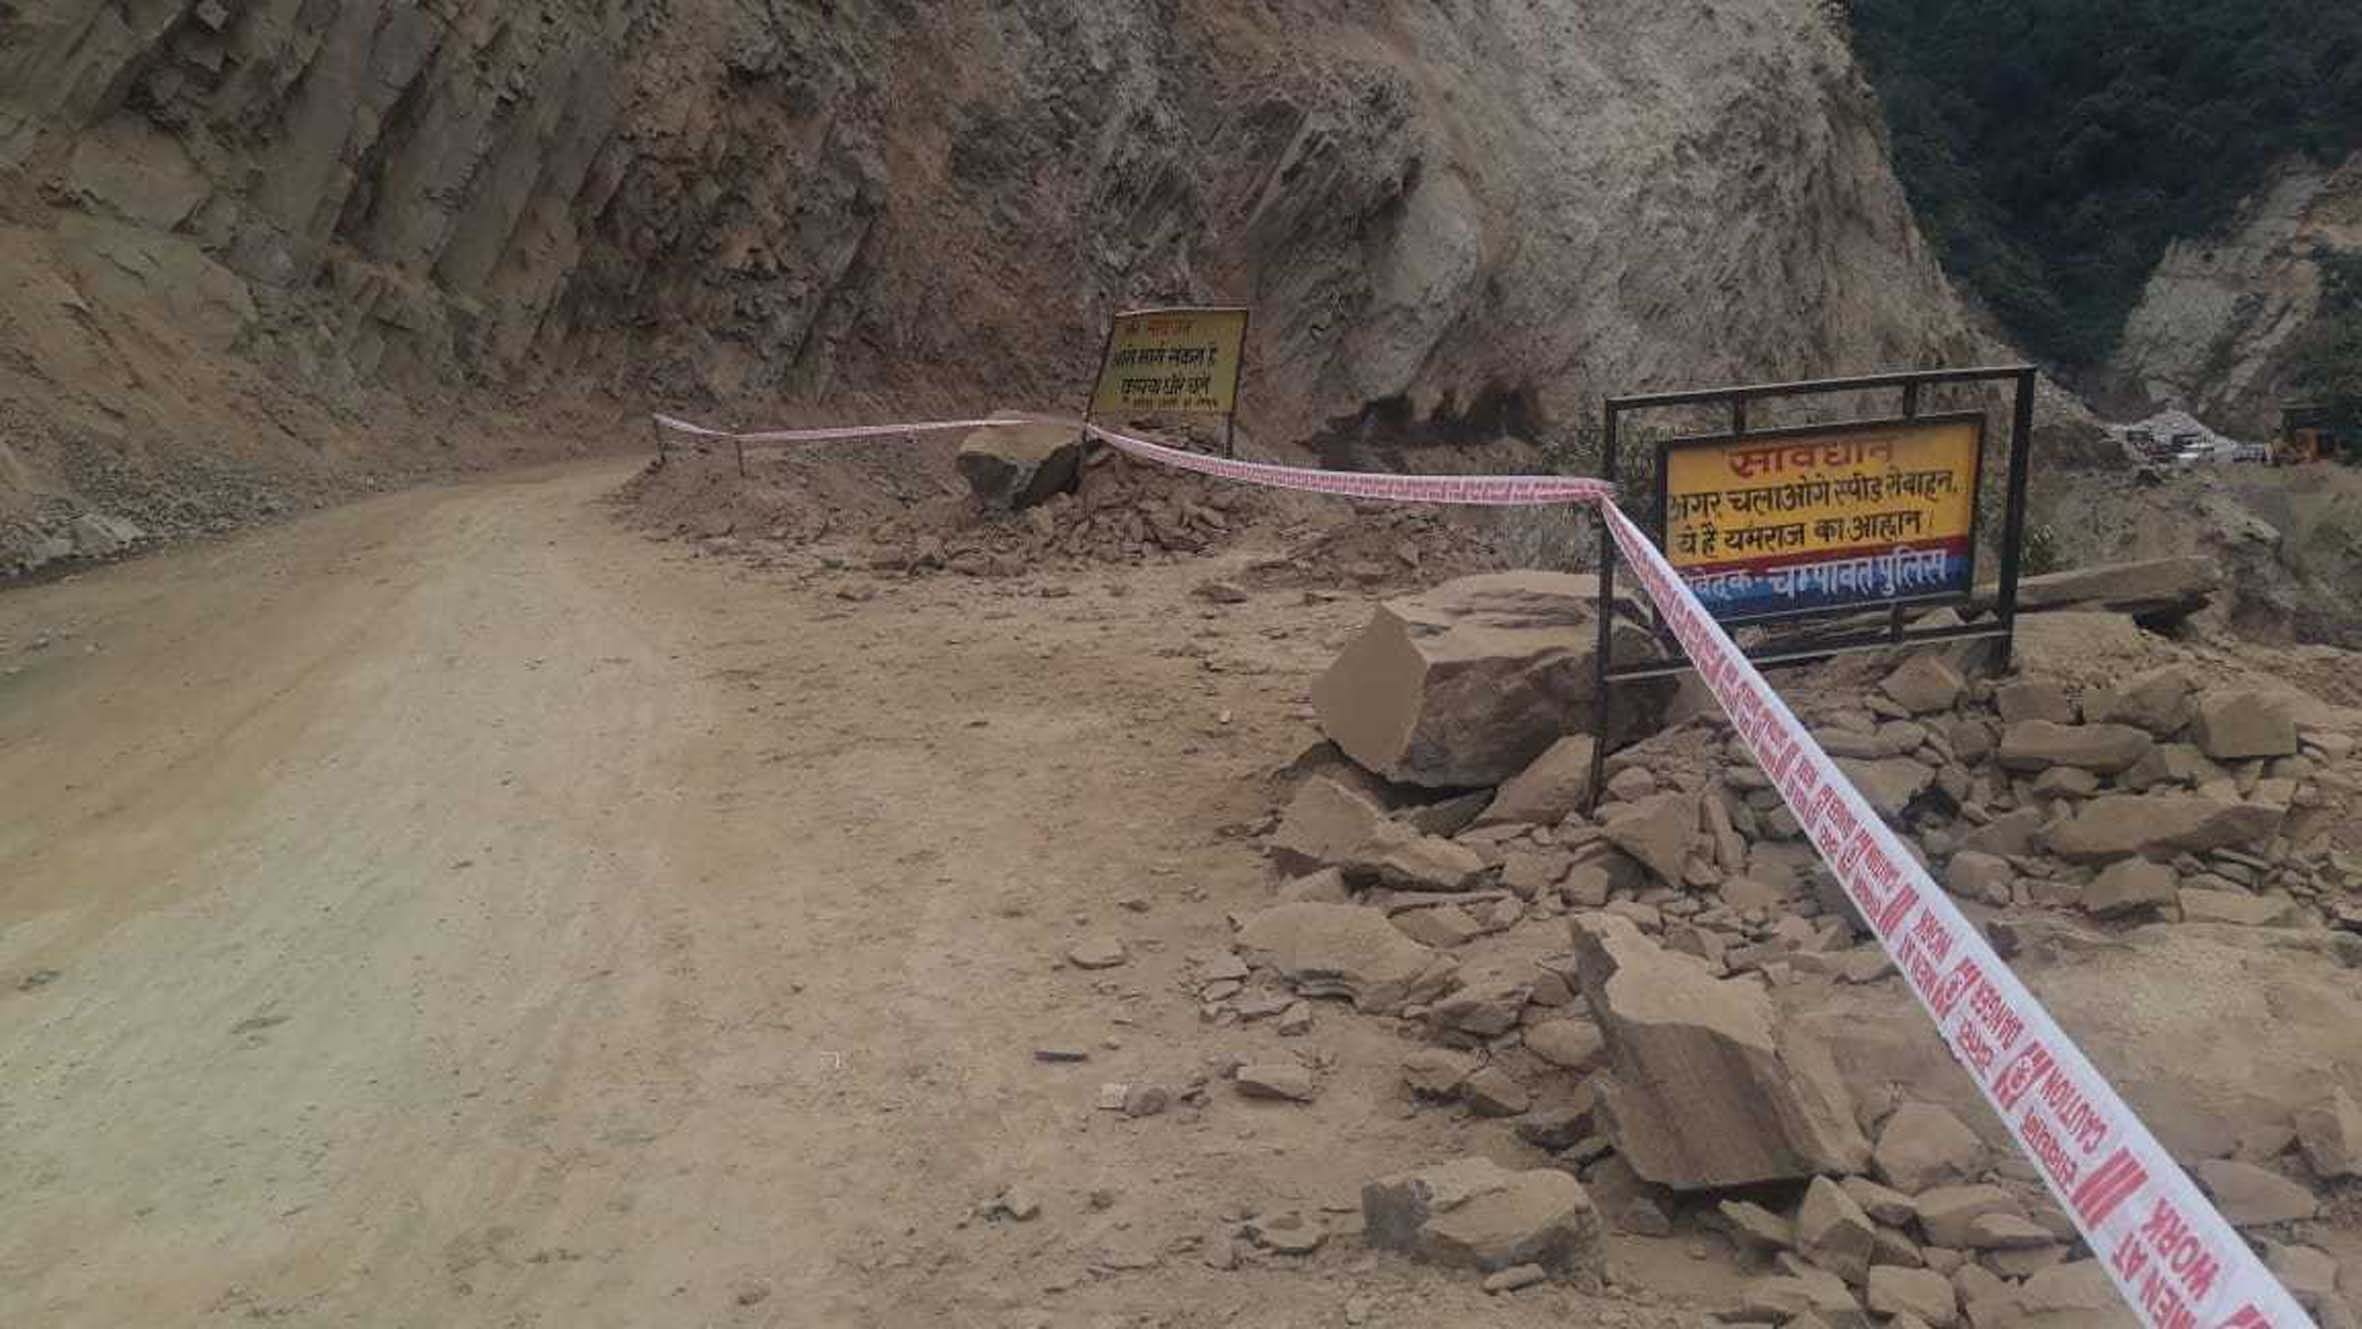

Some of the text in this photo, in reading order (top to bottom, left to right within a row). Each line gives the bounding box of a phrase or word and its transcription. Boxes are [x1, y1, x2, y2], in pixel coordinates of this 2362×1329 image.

[1728, 438, 1894, 479] सावधान
[1668, 491, 1722, 522] अगर
[1813, 516, 1845, 543] का
[1879, 545, 1948, 595] पुलिस
[2040, 1065, 2108, 1154] CAUTION
[2111, 1232, 2149, 1283] AT
[2141, 1197, 2220, 1302] WORK
